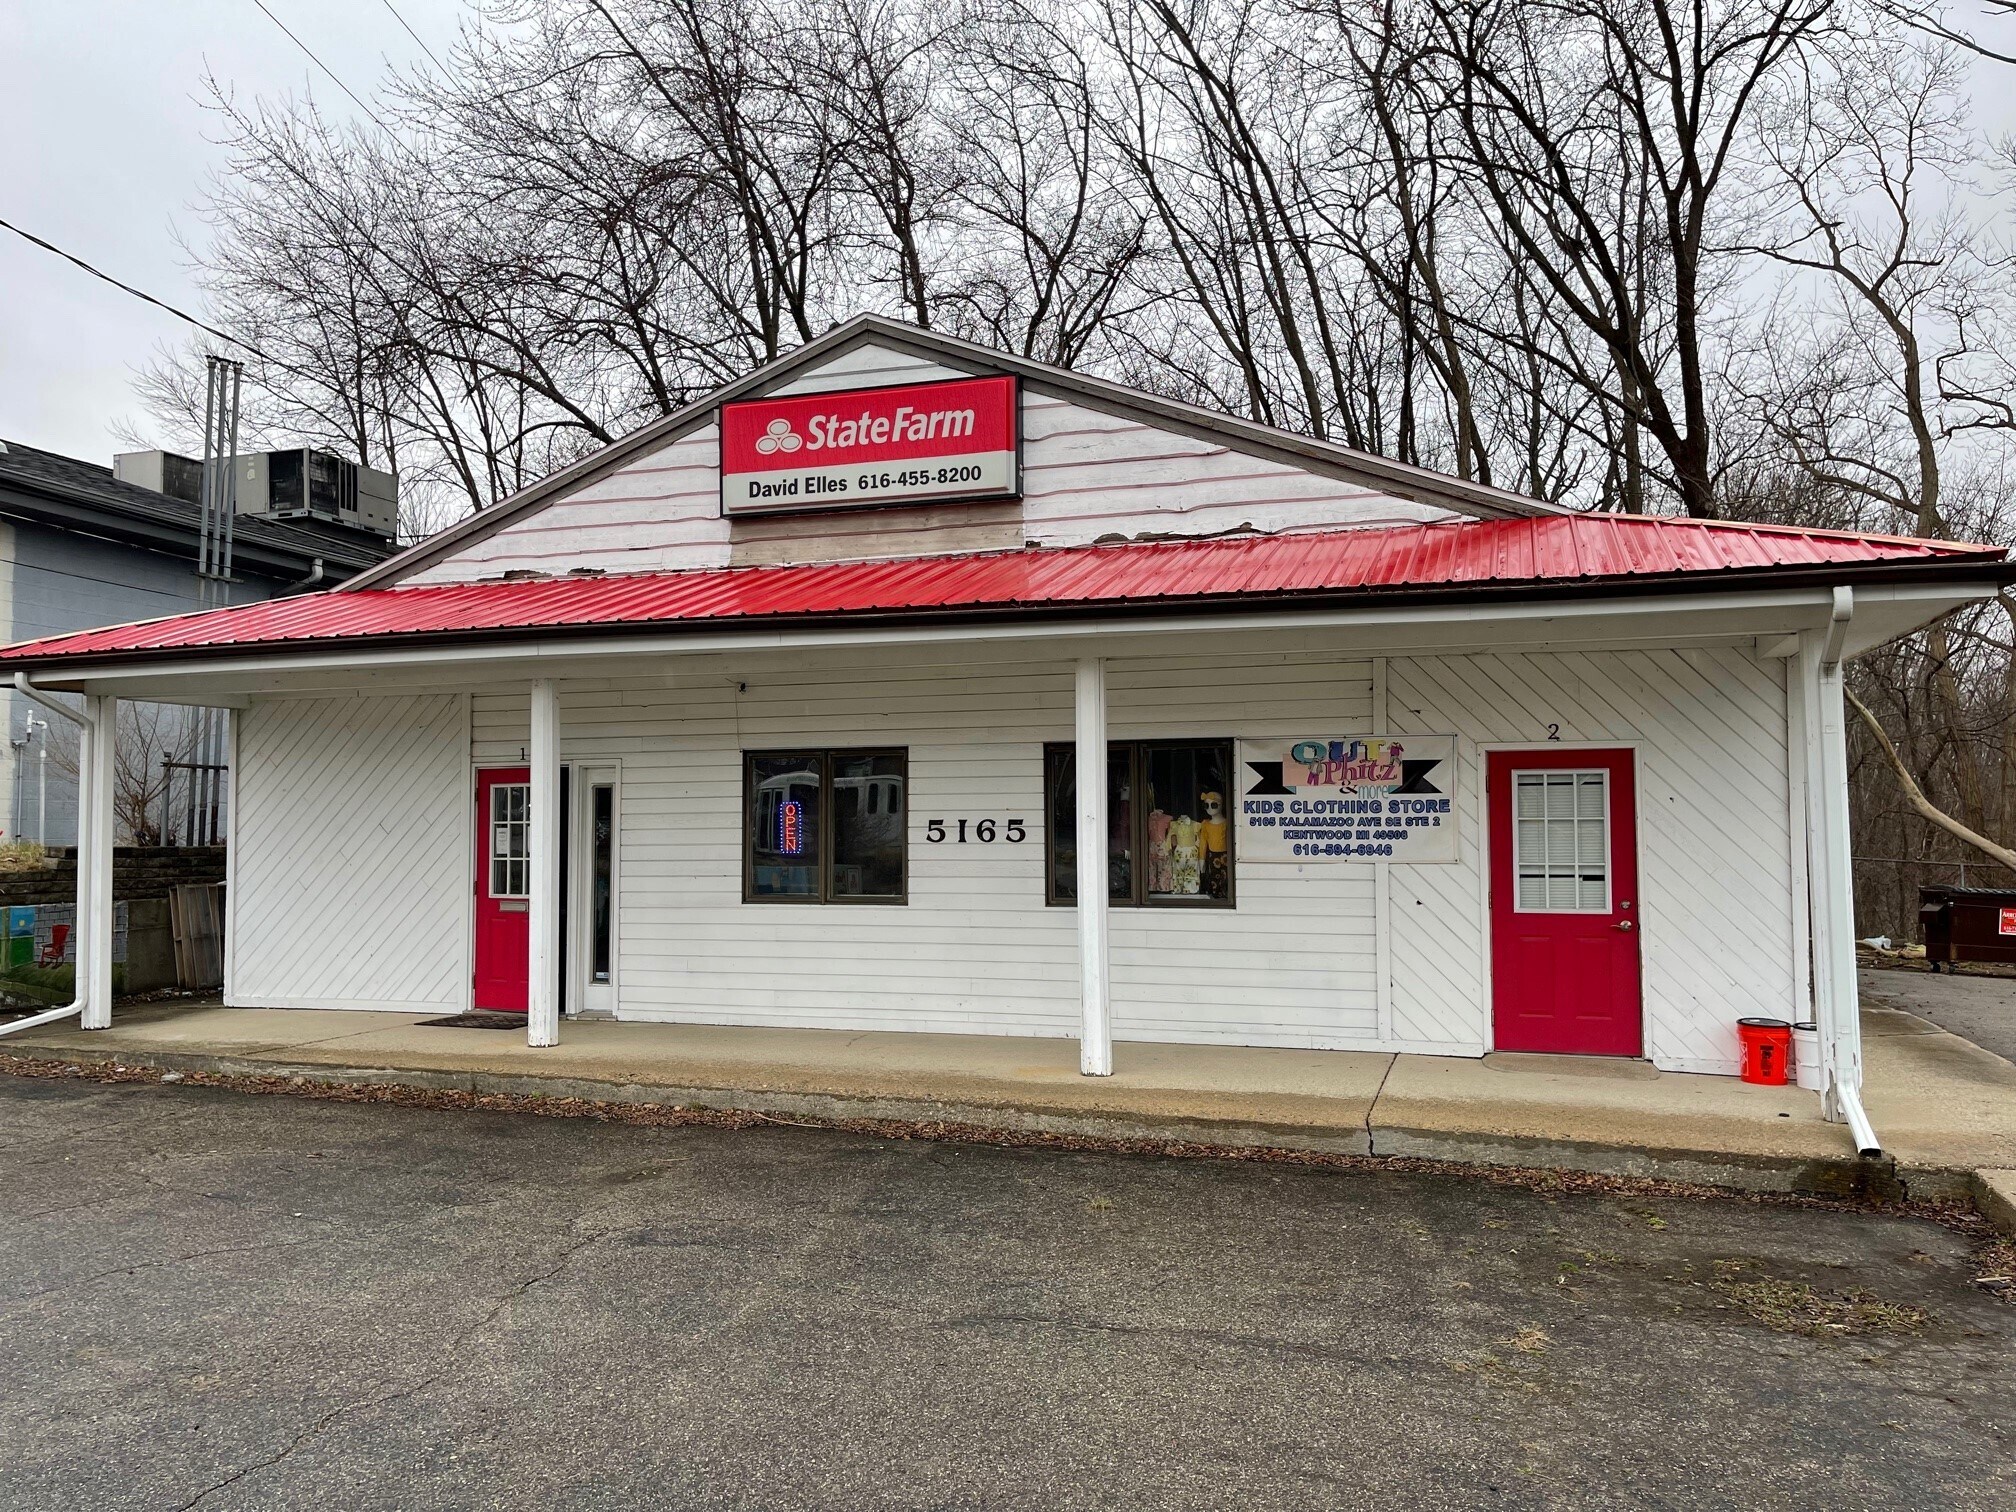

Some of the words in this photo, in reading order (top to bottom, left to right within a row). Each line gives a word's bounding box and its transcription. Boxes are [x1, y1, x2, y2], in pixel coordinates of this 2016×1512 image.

[749, 478, 799, 498] David
[805, 475, 848, 494] Elles
[858, 465, 982, 490] 616-455-8200
[1547, 723, 1560, 740] 2
[520, 747, 526, 760] 1
[1291, 740, 1386, 764] OUT
[1321, 752, 1398, 785] Phitz
[1339, 780, 1358, 795] &
[1358, 785, 1389, 799] more
[1243, 800, 1285, 814] KIDS
[1290, 800, 1382, 814] CLOTHING
[1388, 799, 1450, 813] STORE
[785, 804, 796, 850] OPEN
[1249, 816, 1276, 827] 5165
[1279, 816, 1355, 827] KALAMAZOO
[1357, 816, 1382, 827] AVE
[1385, 816, 1402, 827] SE
[1405, 816, 1429, 827] STE
[1432, 815, 1441, 827] 2
[926, 819, 1026, 843] 5165
[1283, 829, 1353, 840] KENTWOOD
[1355, 829, 1370, 840] MI
[1372, 829, 1408, 840] 49508
[1292, 843, 1393, 856] 616-594-6946
